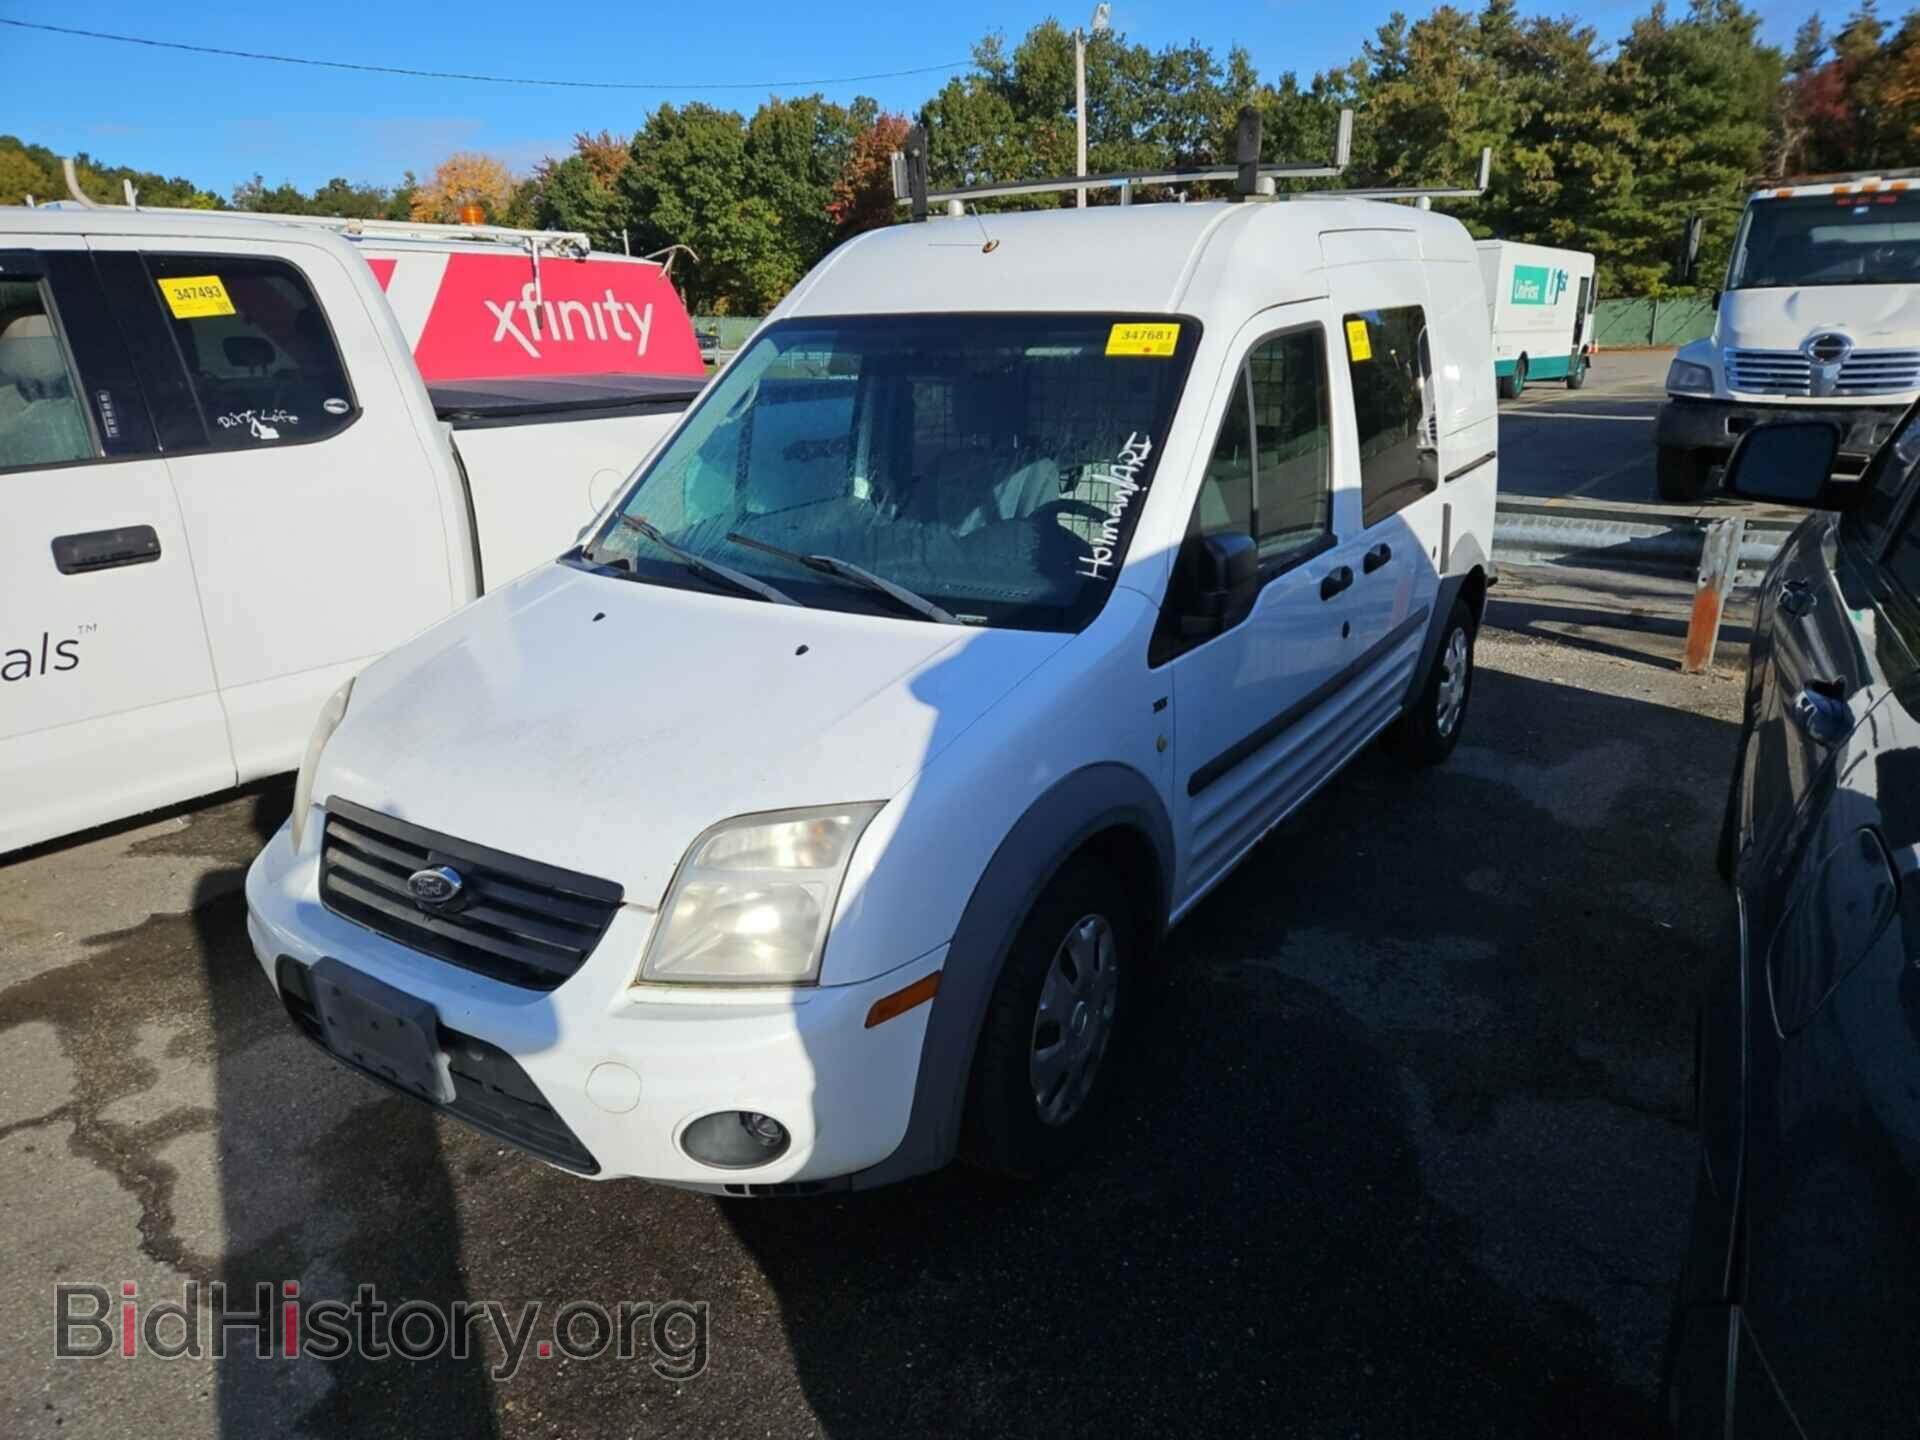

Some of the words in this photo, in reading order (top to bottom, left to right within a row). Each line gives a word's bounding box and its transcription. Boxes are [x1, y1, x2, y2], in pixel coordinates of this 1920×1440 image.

[174, 285, 222, 300] 347493
[484, 282, 653, 359] xfinity
[1120, 329, 1173, 340] 347681
[260, 408, 299, 425] Life
